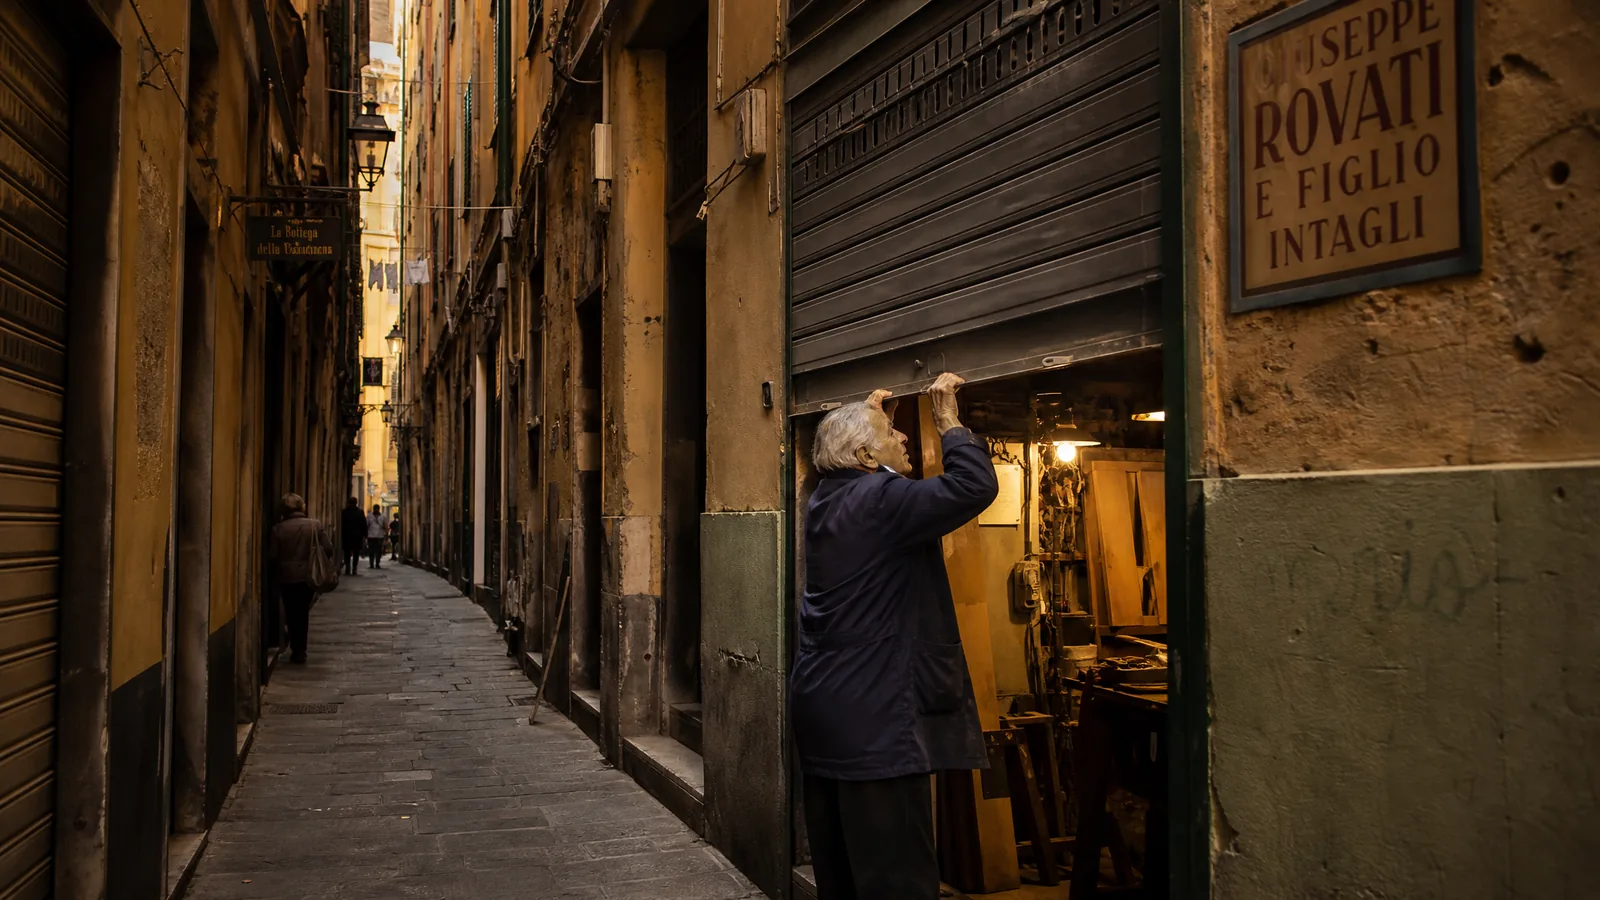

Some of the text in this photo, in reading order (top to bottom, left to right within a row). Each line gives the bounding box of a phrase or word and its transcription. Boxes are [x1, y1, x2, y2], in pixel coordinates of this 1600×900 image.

[1253, 40, 1444, 170] ROVATI
[1255, 133, 1441, 220] E FIGLIO
[257, 243, 280, 255] della
[270, 225, 281, 238] La
[1269, 195, 1425, 269] INTAGLI
